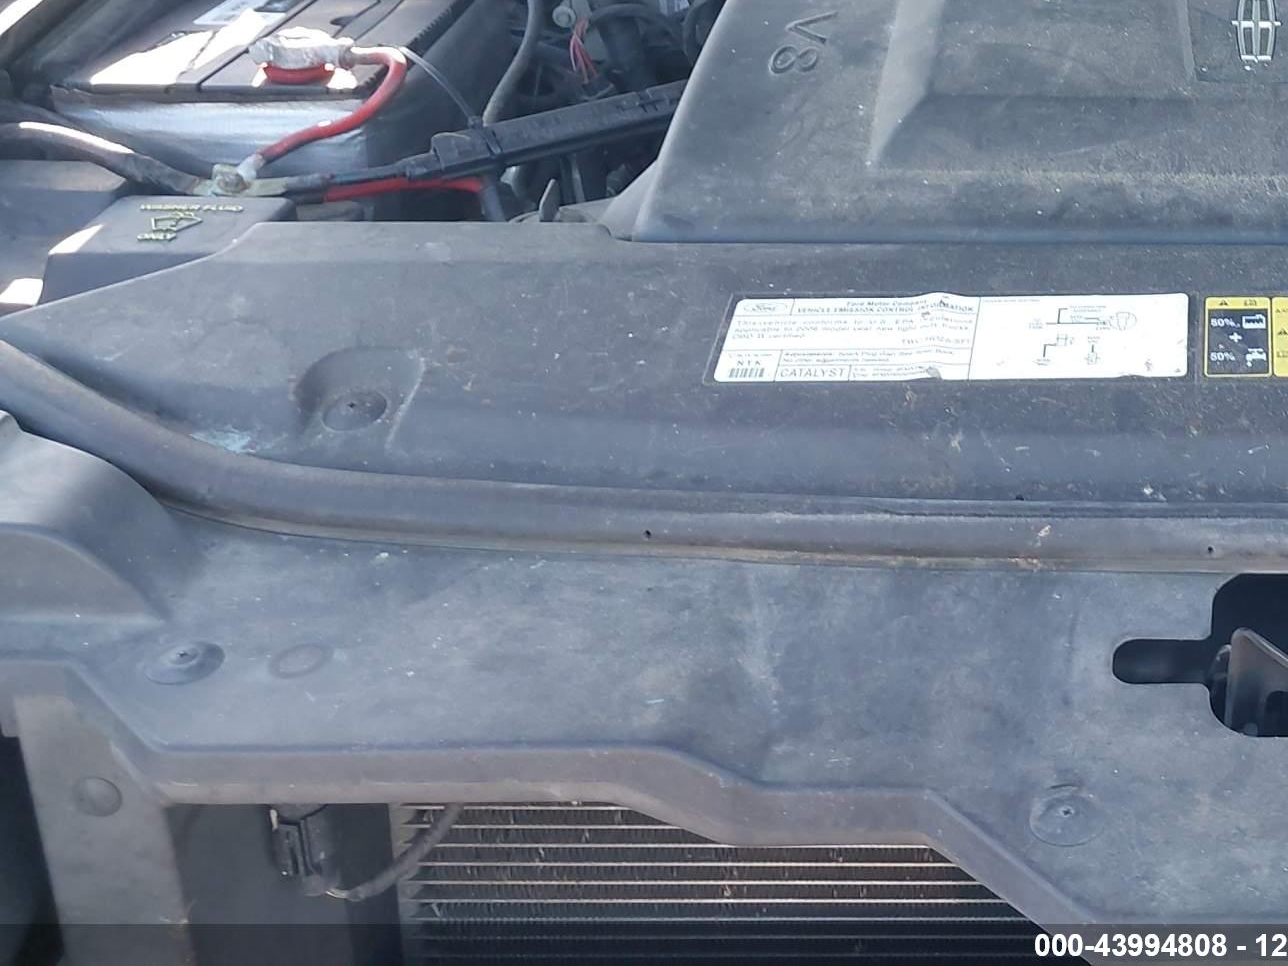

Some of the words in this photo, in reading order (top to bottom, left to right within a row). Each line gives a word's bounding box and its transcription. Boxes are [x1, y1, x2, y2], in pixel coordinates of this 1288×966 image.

[768, 10, 839, 74] V8
[1210, 318, 1236, 328] 50%
[1210, 351, 1236, 362] 50%
[780, 367, 846, 377] CATALYST
